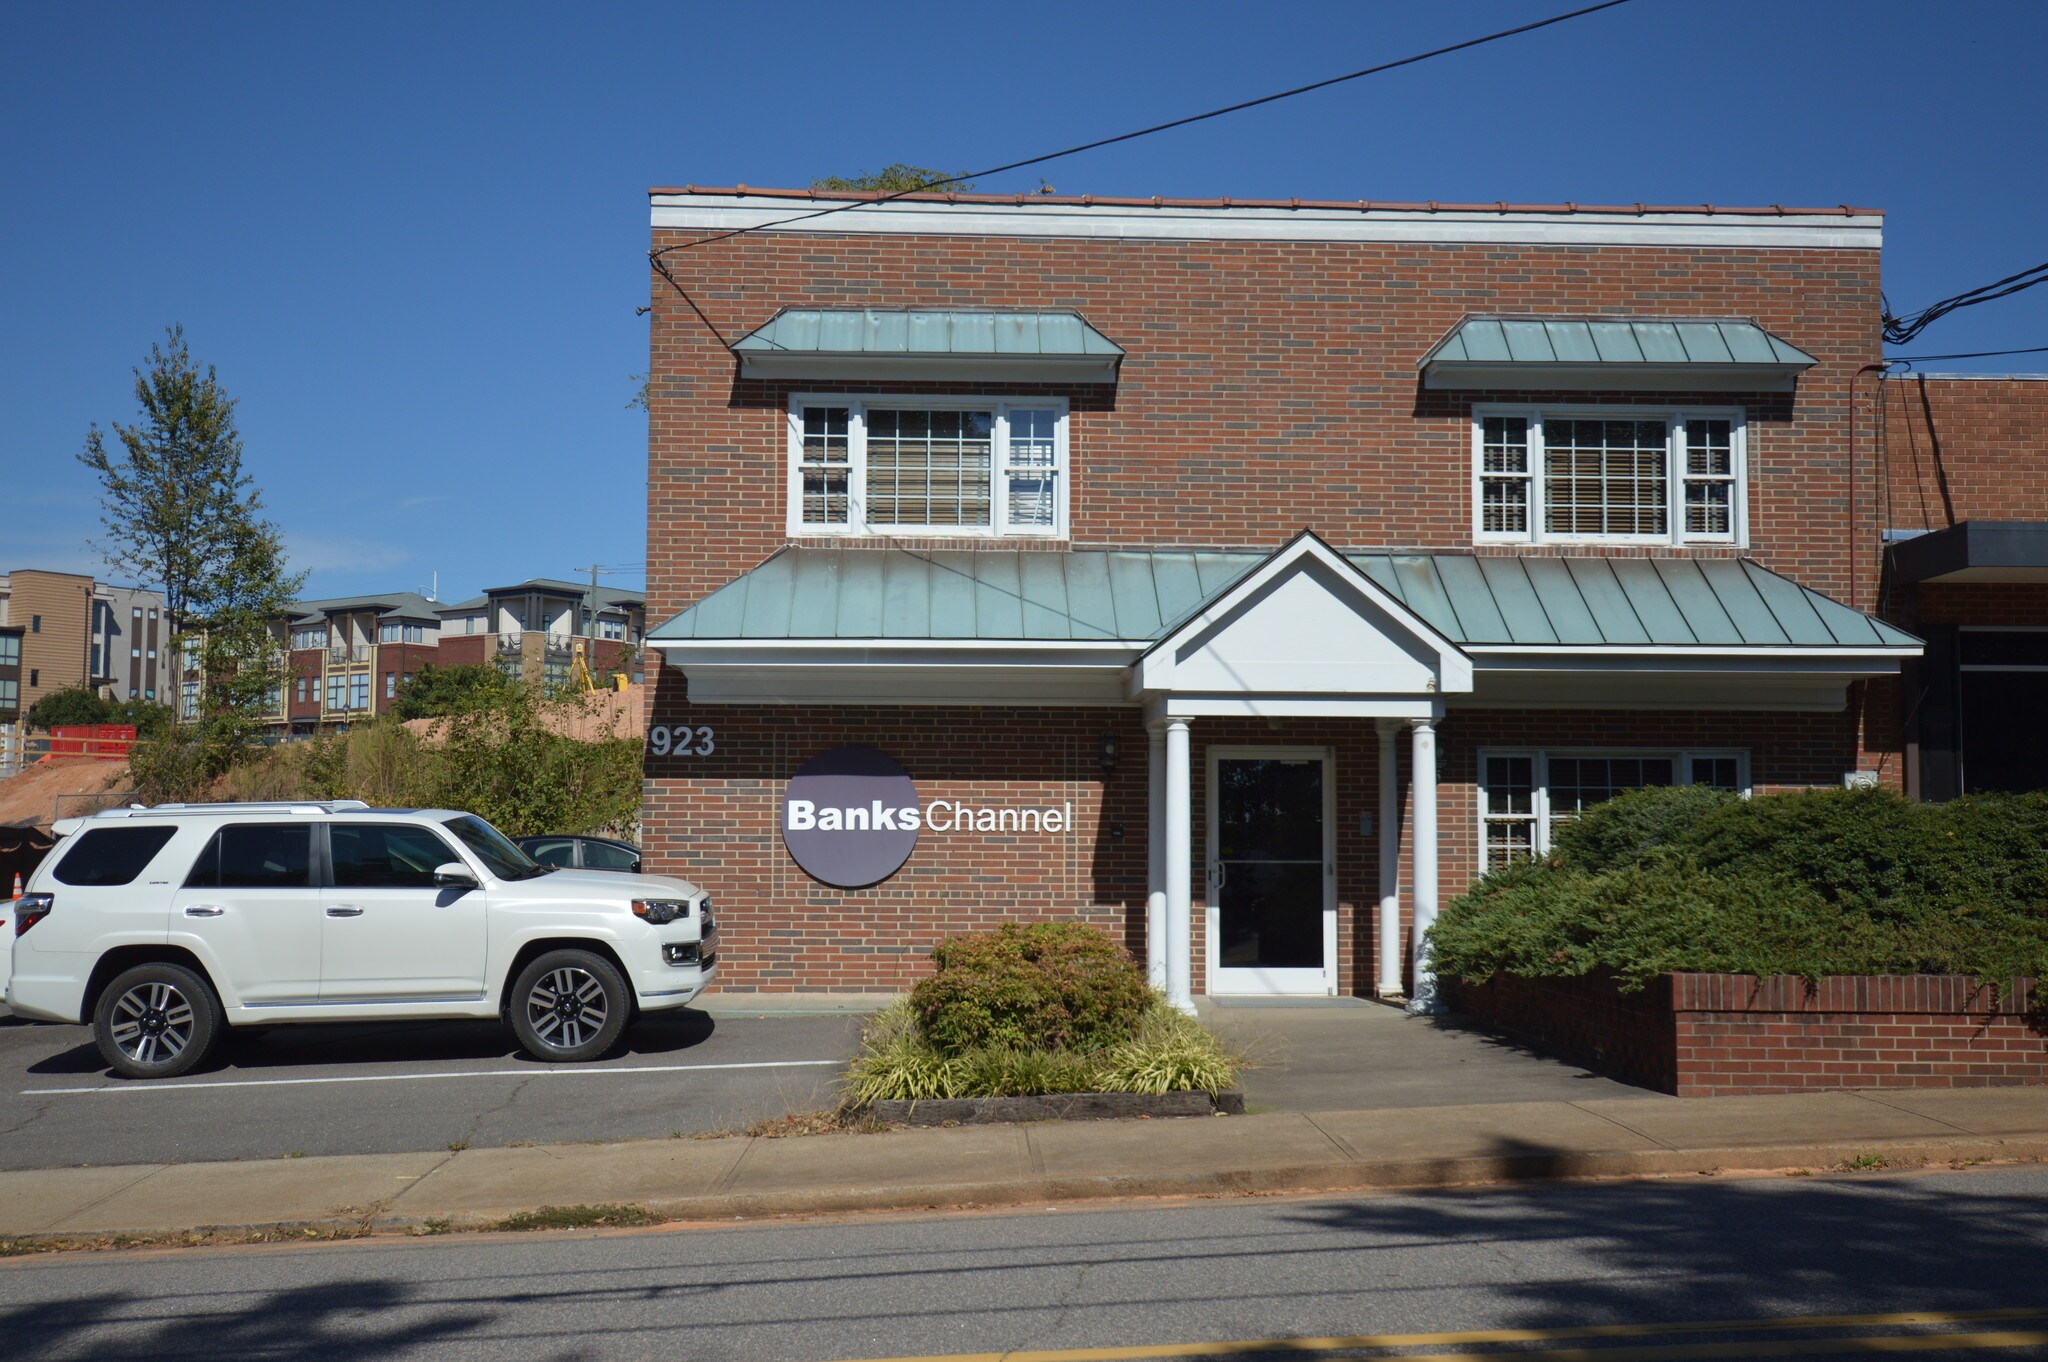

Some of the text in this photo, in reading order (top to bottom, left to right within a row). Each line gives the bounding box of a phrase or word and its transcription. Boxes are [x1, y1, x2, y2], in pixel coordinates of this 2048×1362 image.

[651, 726, 715, 756] 923
[787, 800, 1072, 833] Banks Channel
